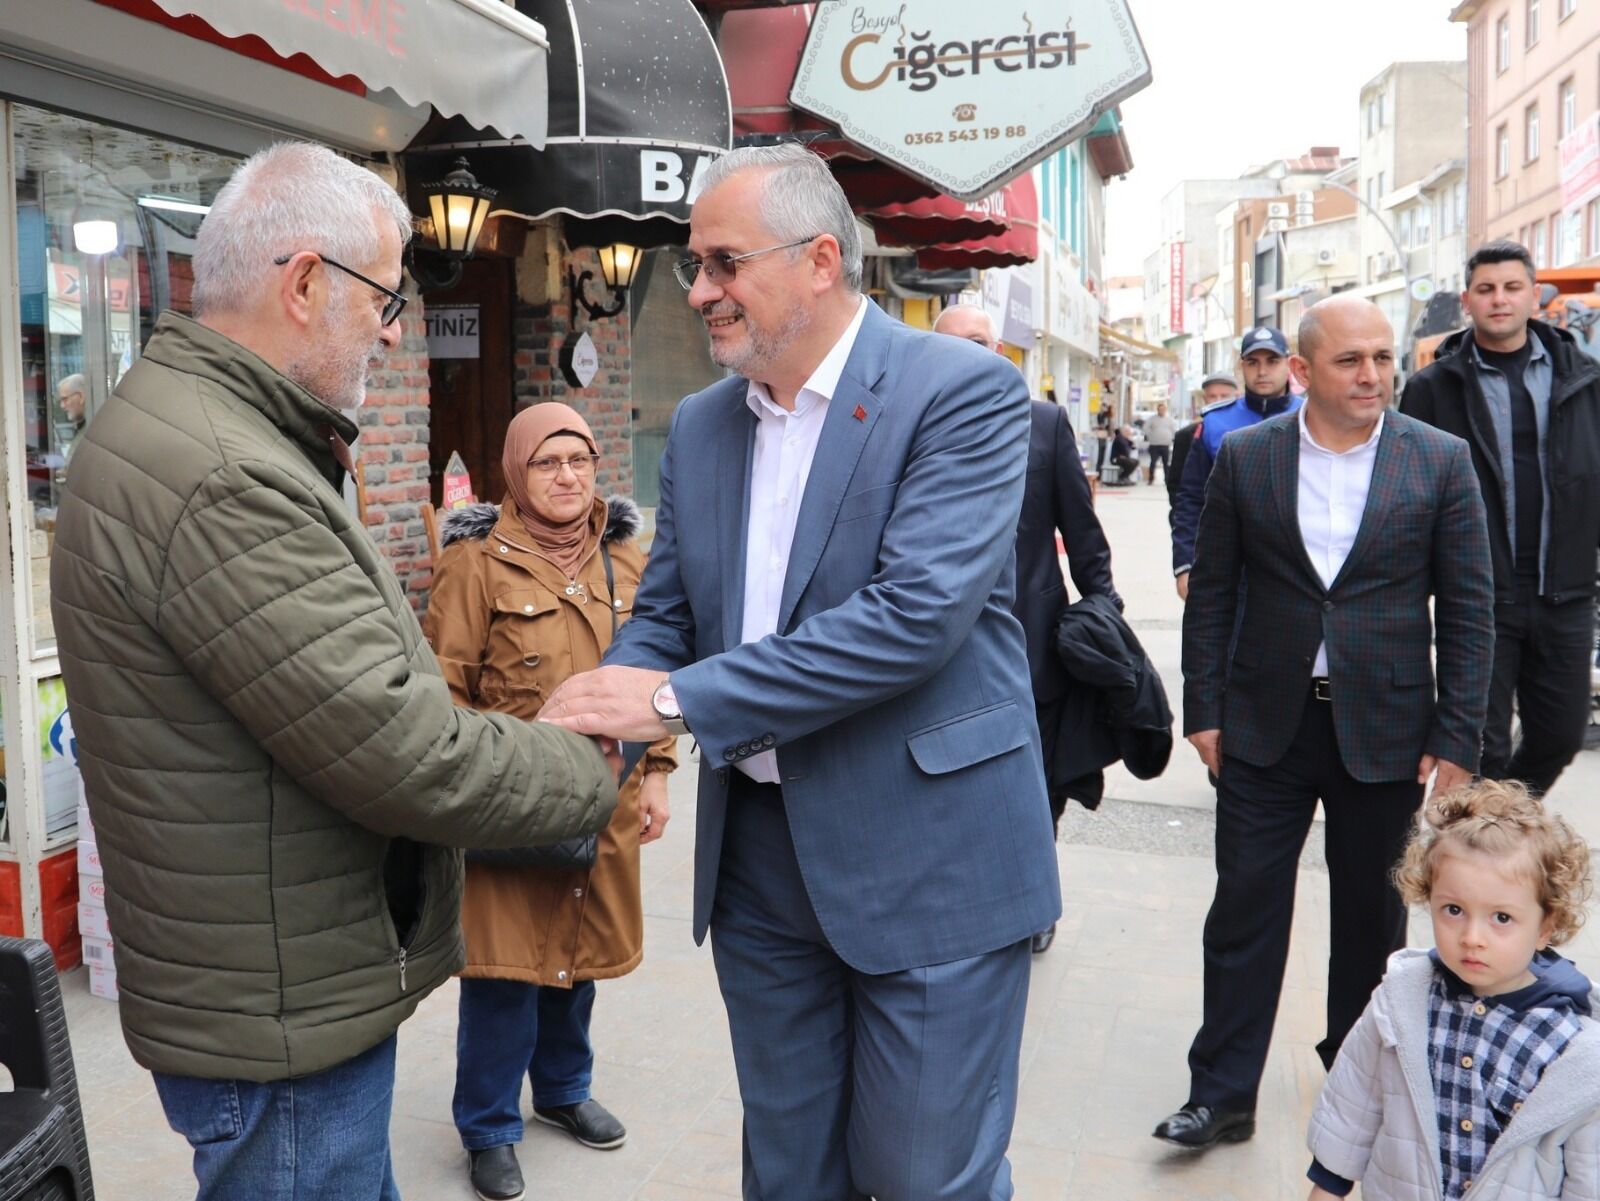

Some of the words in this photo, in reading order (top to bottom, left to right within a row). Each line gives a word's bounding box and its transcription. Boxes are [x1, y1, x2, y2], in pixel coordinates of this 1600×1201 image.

[904, 131, 944, 146] 0362
[948, 129, 979, 142] 543
[983, 127, 1000, 140] 19
[1005, 125, 1026, 138] 88
[423, 313, 478, 337] TİNİZ
